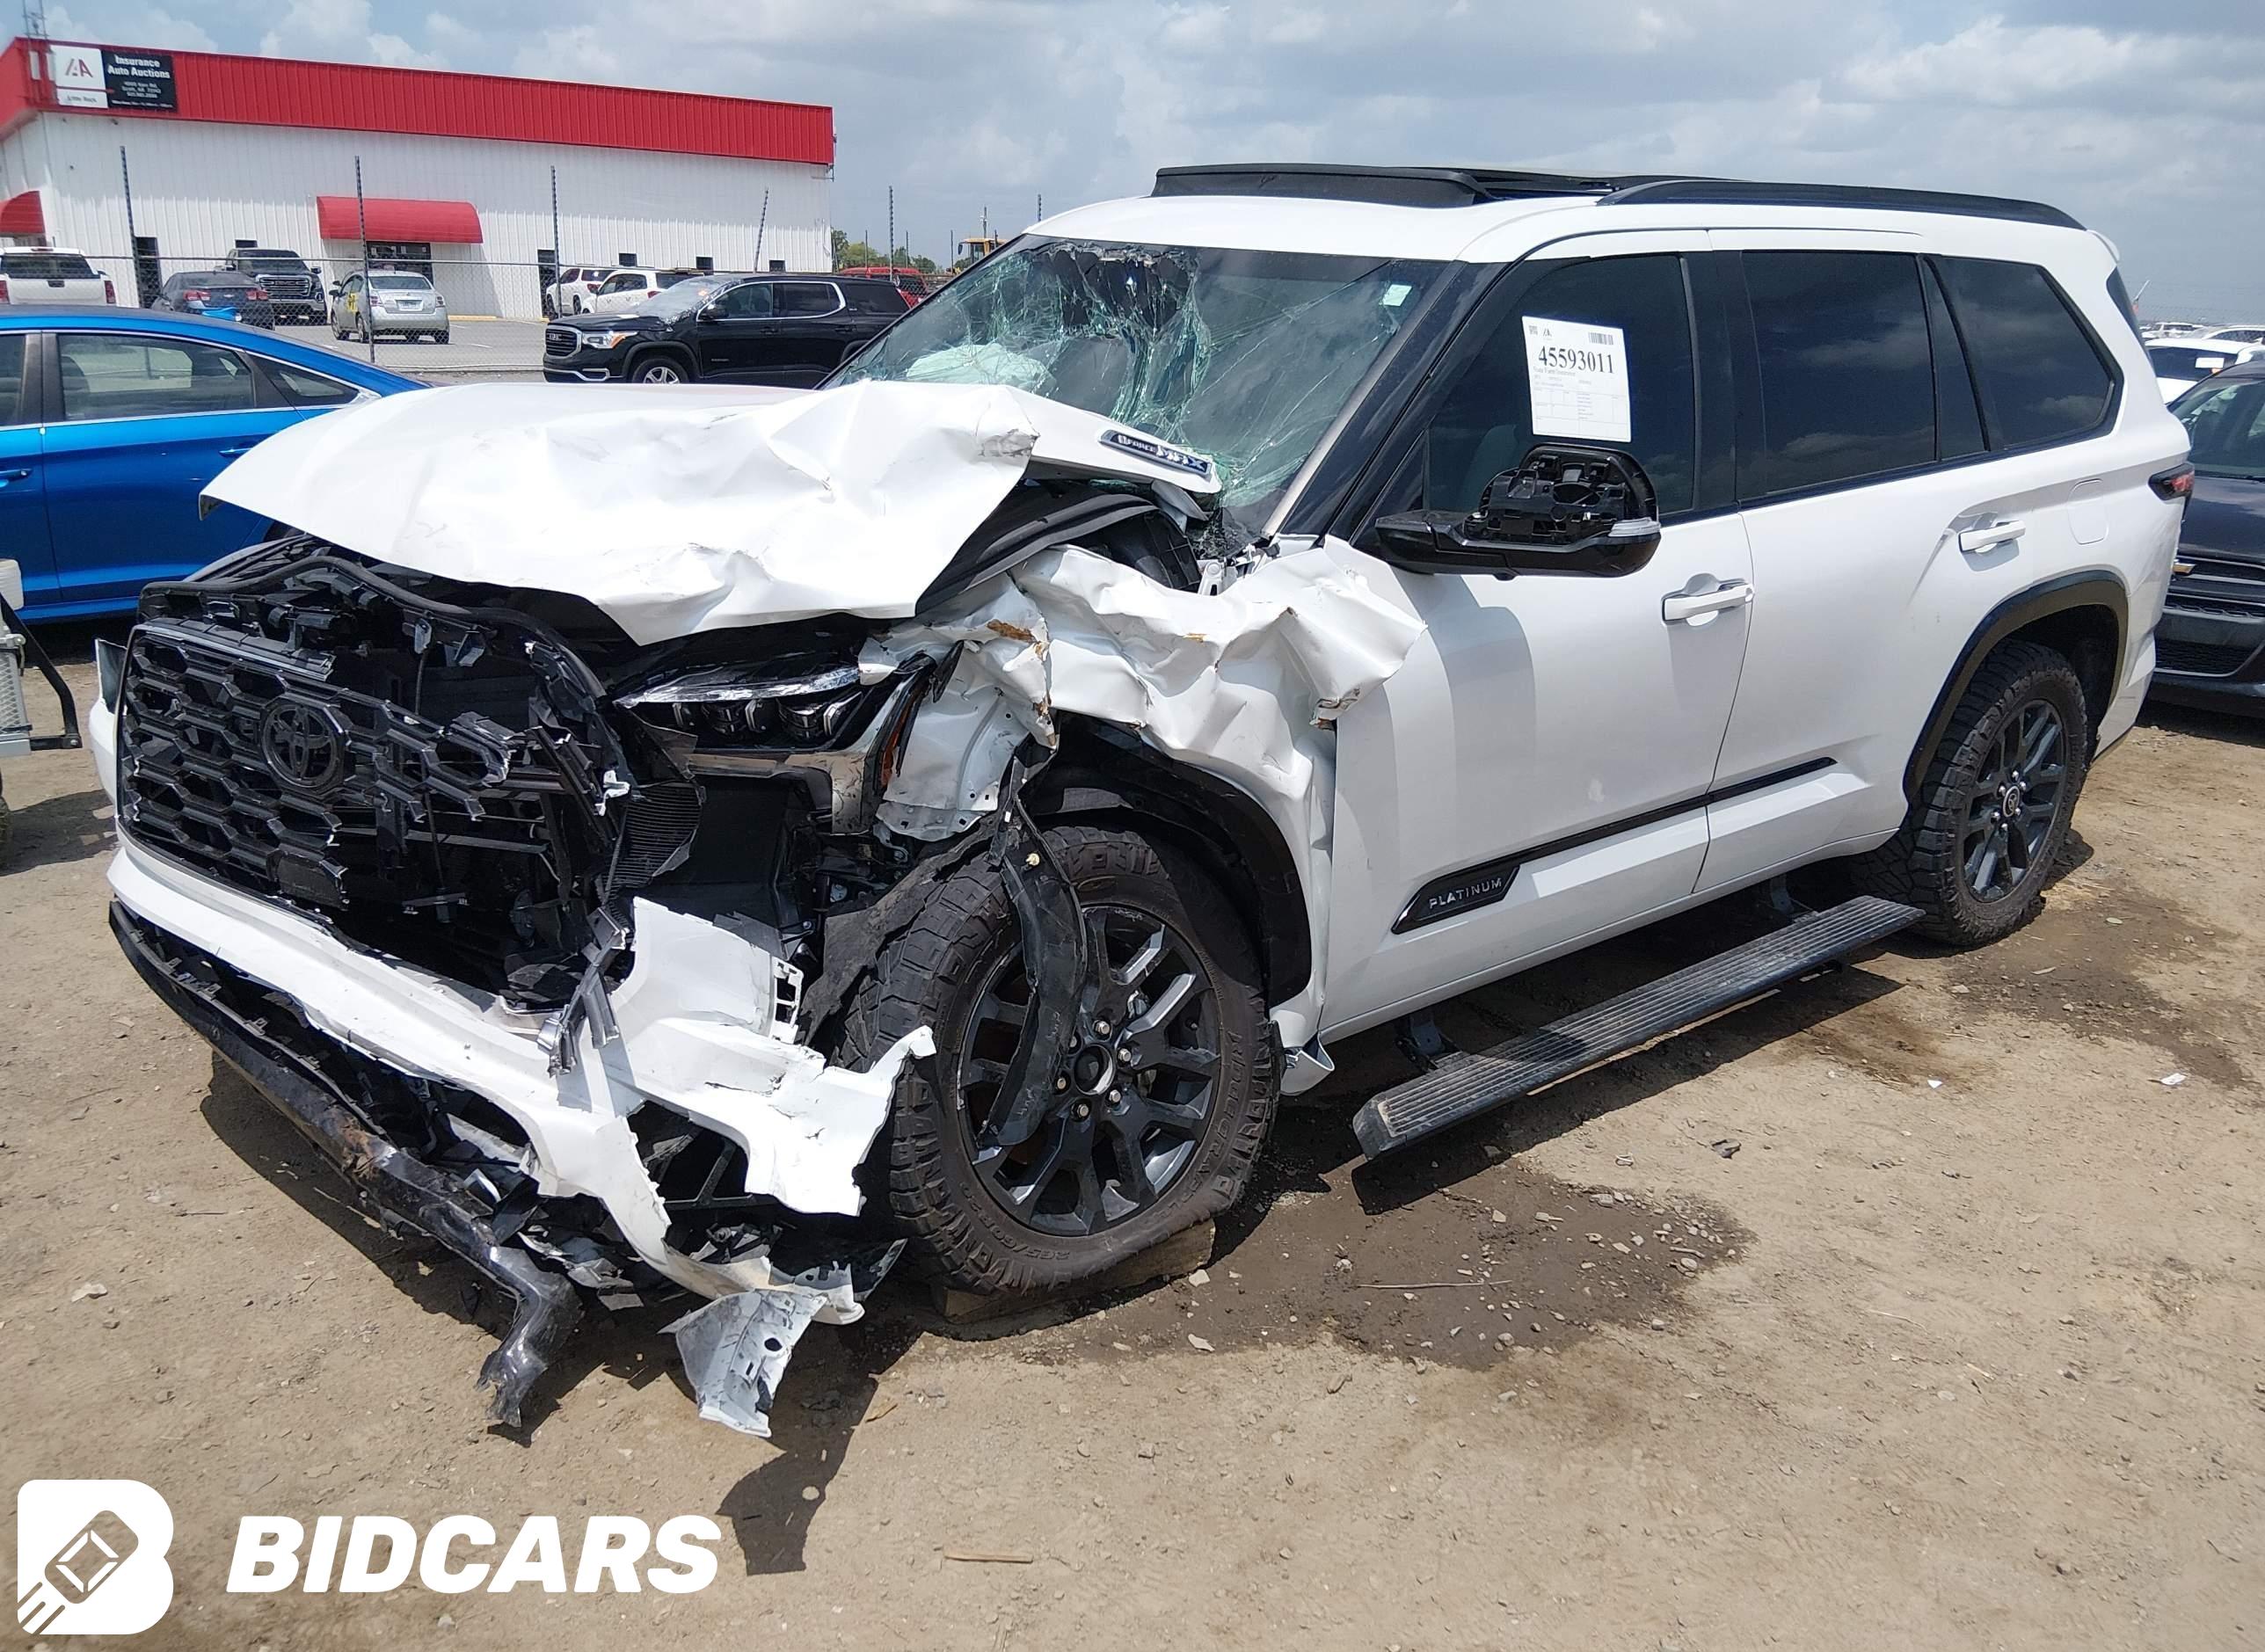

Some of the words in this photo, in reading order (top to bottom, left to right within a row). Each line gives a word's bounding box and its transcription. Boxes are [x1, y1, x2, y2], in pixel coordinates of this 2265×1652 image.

[107, 64, 129, 76] Auto
[131, 66, 171, 79] Auctions
[113, 54, 160, 68] Insurance
[1538, 345, 1614, 375] 45593011
[1429, 877, 1502, 909] PLATINUM
